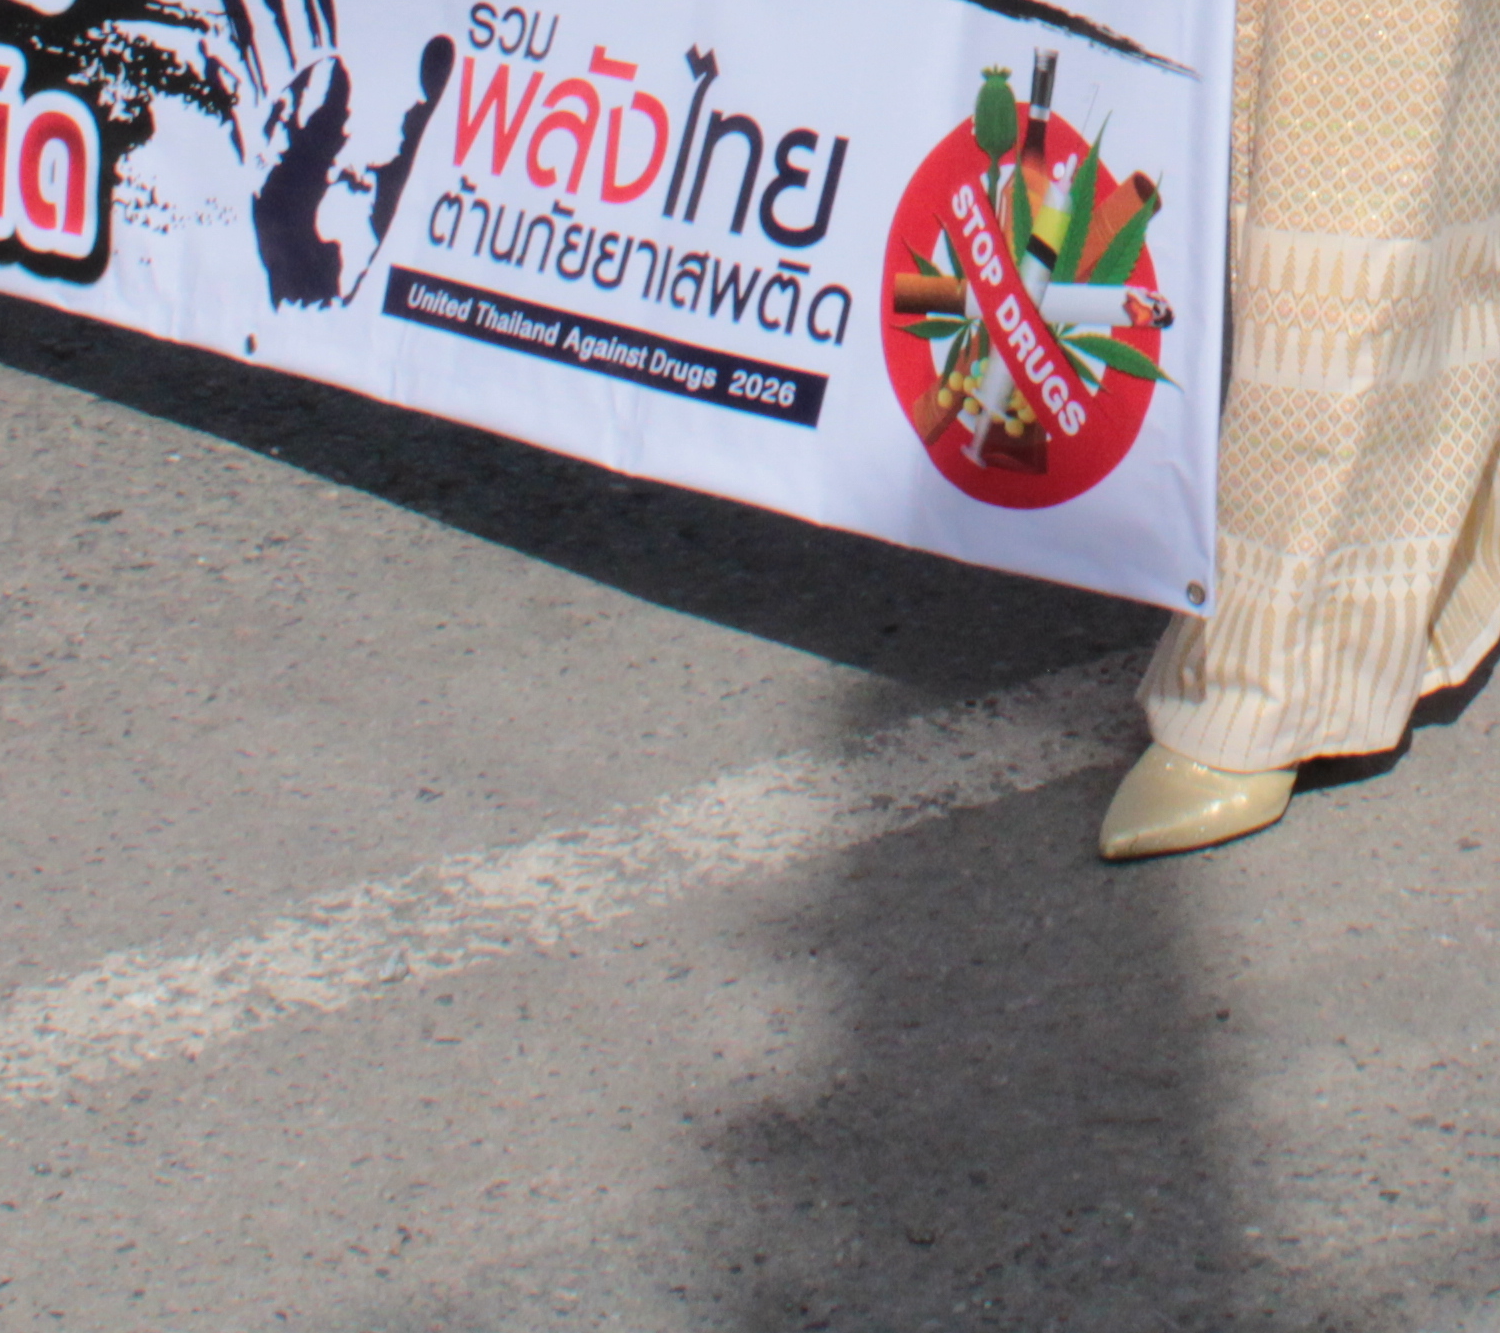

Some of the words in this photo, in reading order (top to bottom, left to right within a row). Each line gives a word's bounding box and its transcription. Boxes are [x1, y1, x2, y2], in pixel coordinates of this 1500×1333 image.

[467, 0, 560, 62] รวม
[452, 42, 850, 249] พลังไทย
[407, 281, 472, 323] United
[475, 300, 560, 348] Thailand
[561, 326, 649, 374] Against
[649, 348, 719, 394] Drugs
[728, 367, 798, 409] 2026
[427, 174, 853, 348] ต้านภัยยาเสพติด
[951, 184, 1006, 288] STOP
[994, 293, 1087, 438] DRUGS
